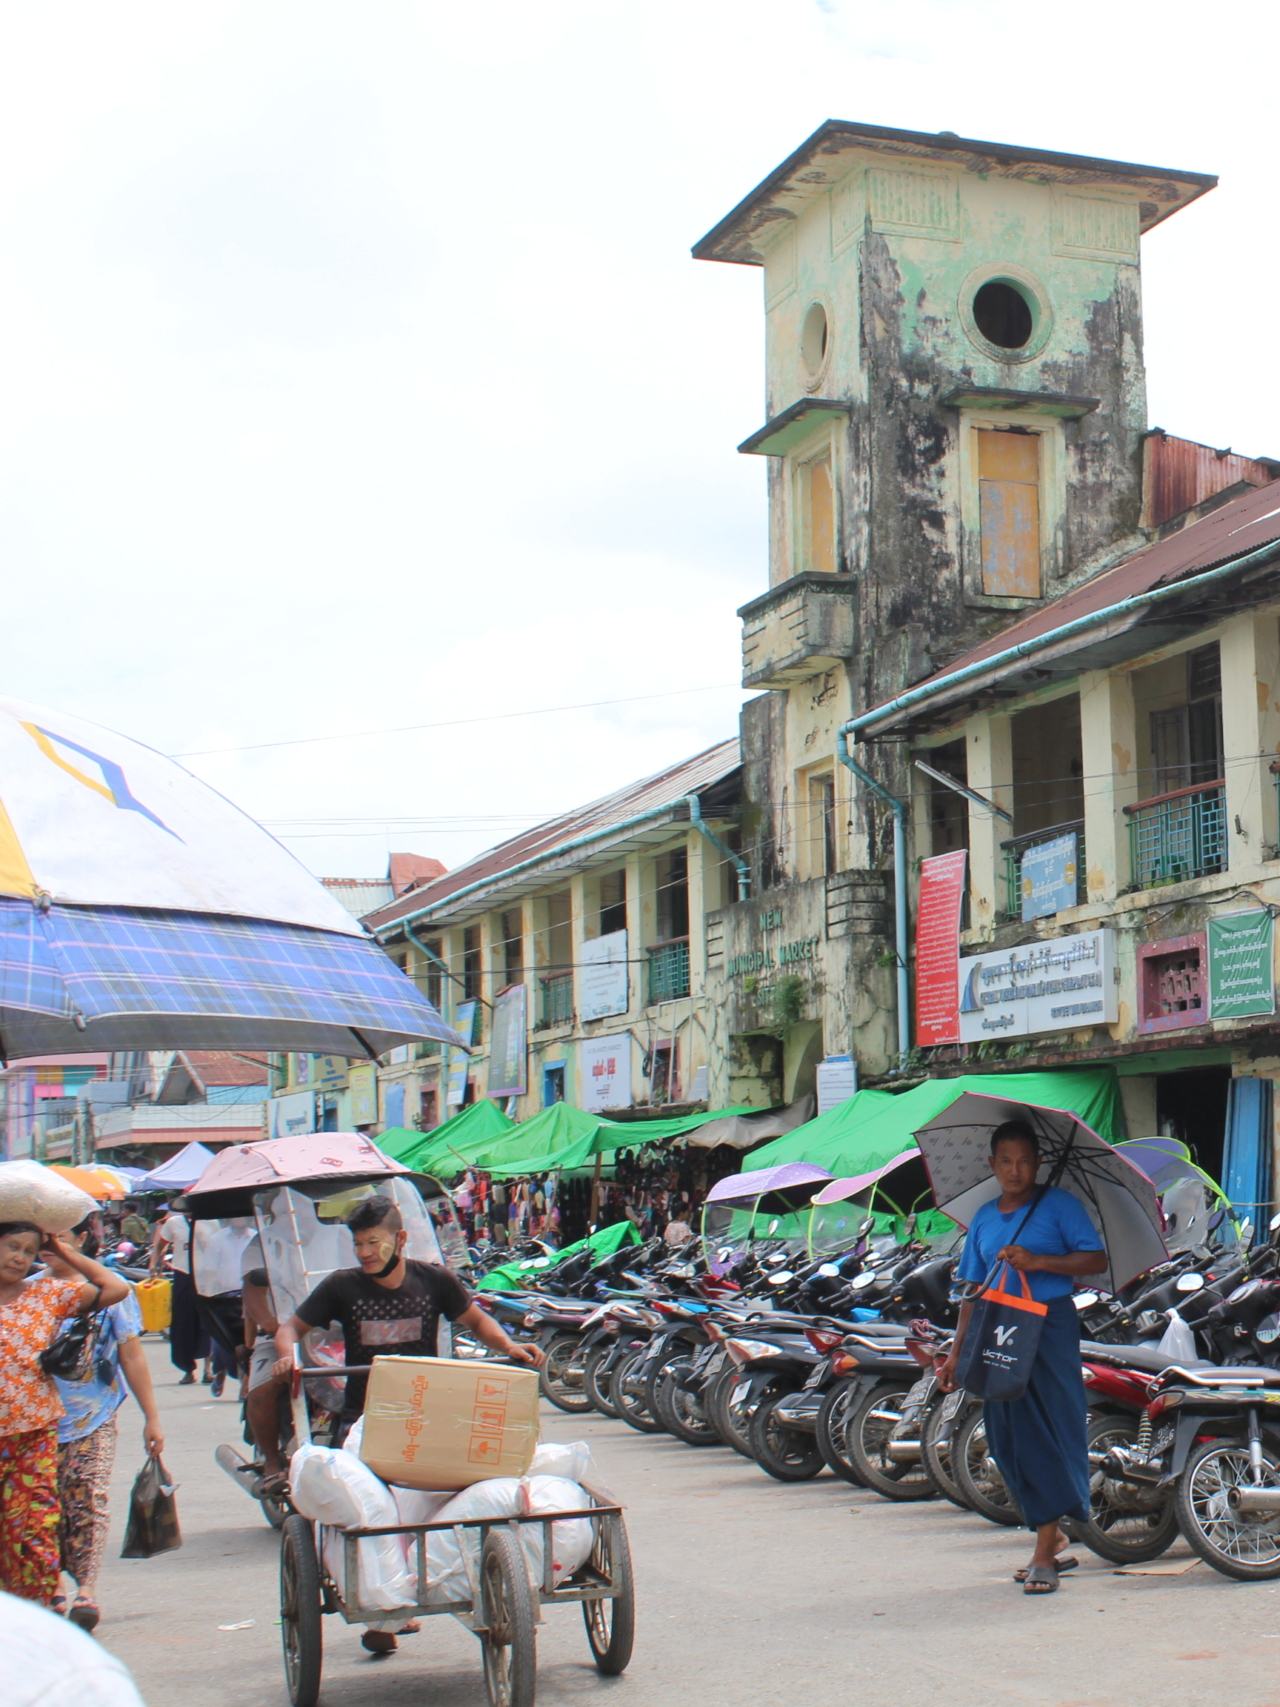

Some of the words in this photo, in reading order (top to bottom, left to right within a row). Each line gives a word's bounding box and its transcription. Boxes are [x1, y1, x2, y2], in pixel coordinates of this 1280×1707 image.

[759, 908, 783, 931] NEW
[728, 949, 776, 977] MUNICIPAL
[779, 936, 820, 966] MARKET
